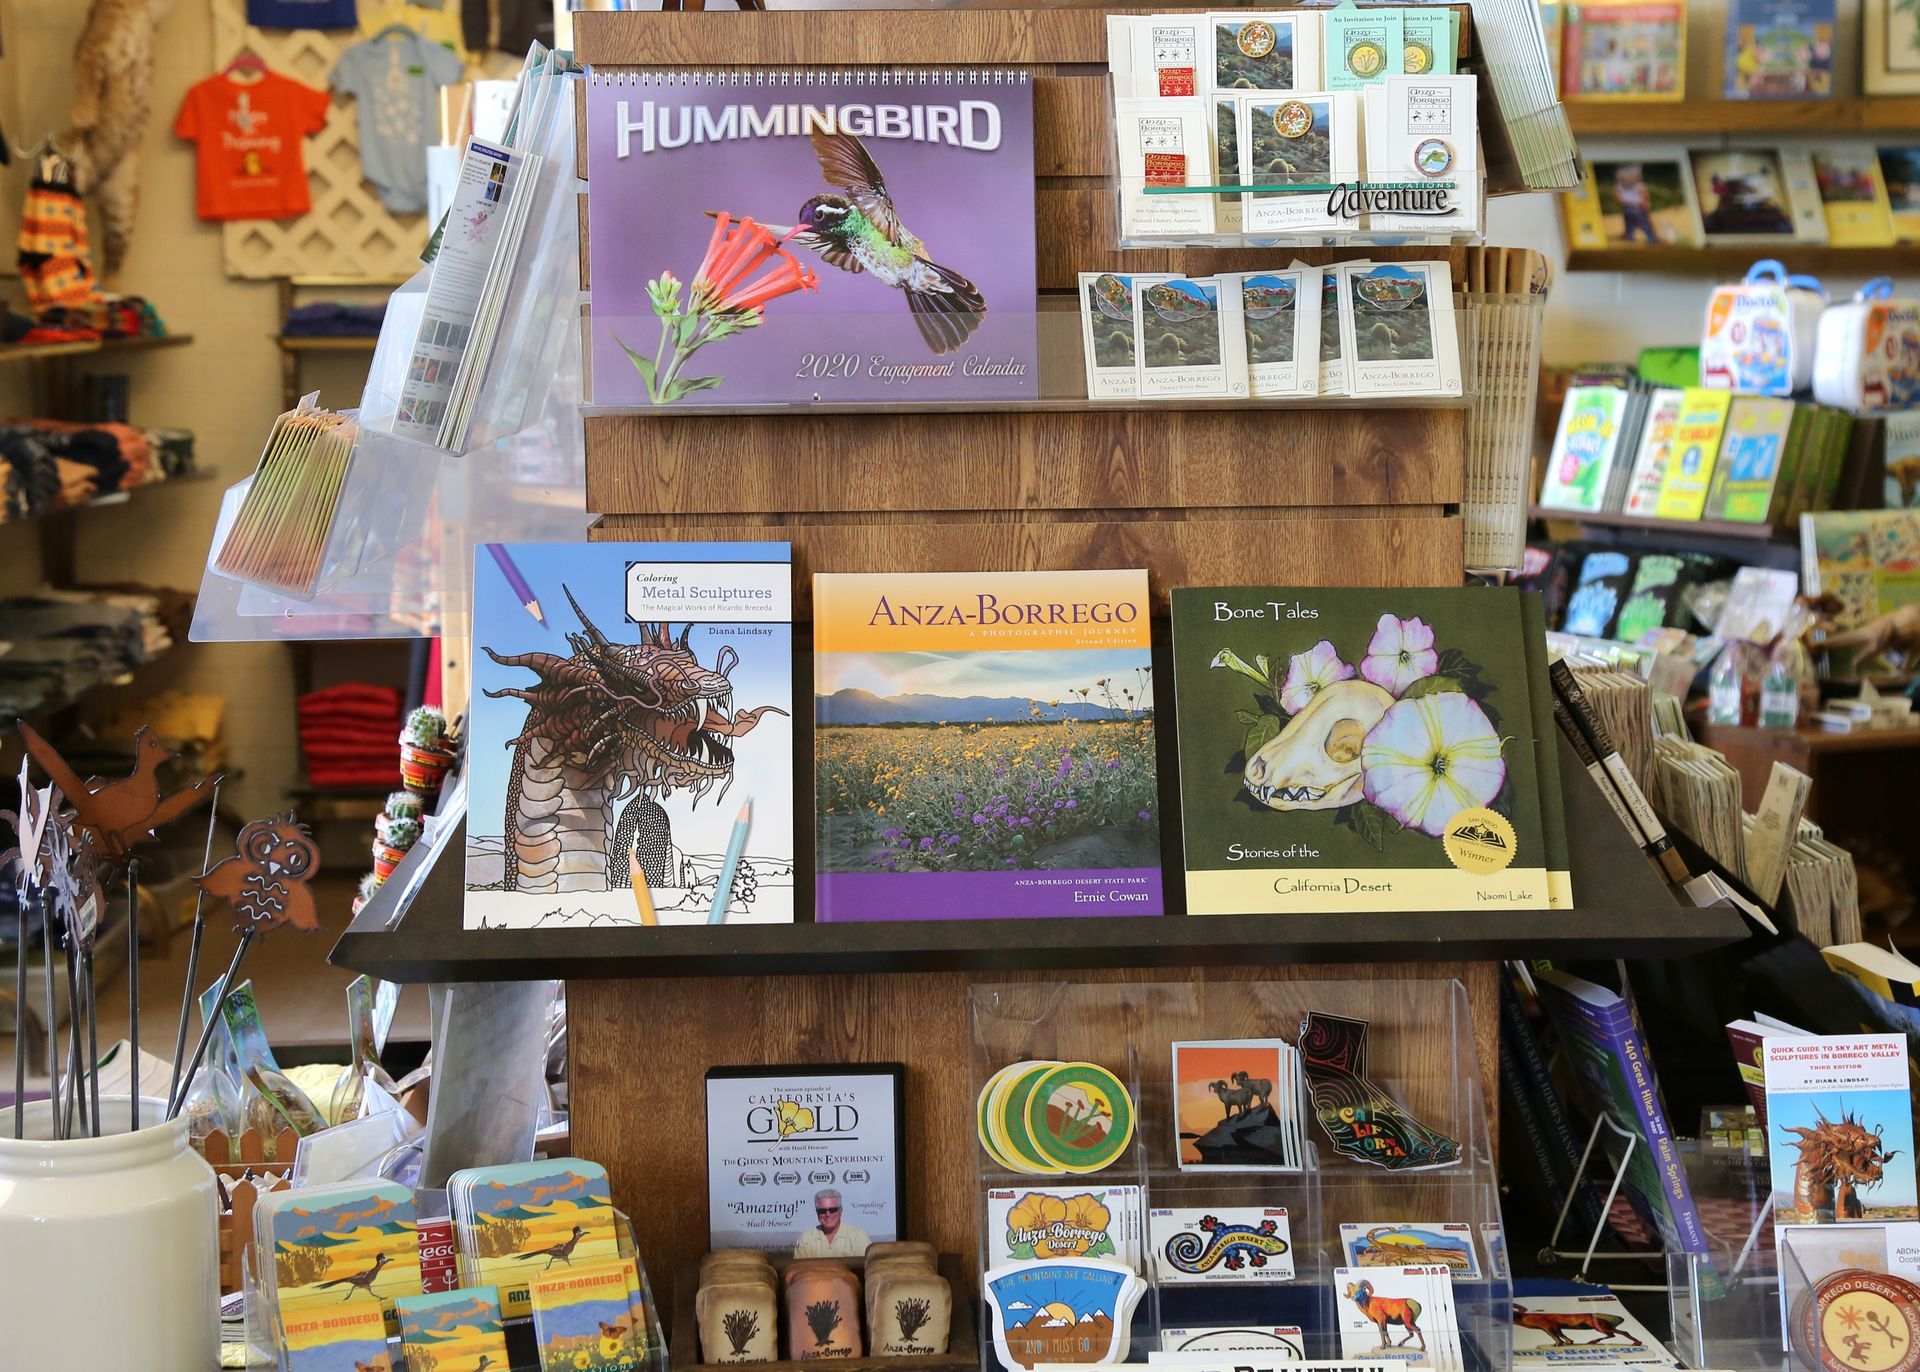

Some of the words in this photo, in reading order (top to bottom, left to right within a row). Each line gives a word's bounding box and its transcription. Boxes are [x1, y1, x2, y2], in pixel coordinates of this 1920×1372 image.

[616, 99, 1002, 159] HUMMINGBIRD
[1326, 180, 1447, 218] Adventure
[795, 352, 861, 379] 2020
[868, 355, 954, 385] Engagement
[962, 354, 1027, 378] Calendar
[1100, 377, 1136, 385] ANZA-B
[1148, 375, 1221, 385] ANZA-BORREGO
[1249, 373, 1292, 382] BORREGO
[1361, 371, 1434, 381] ANZA-BORREGO
[636, 573, 679, 585] Coloring
[641, 586, 685, 599] Metal
[689, 586, 772, 602] Sculptures
[656, 604, 683, 612] Magical
[868, 593, 1138, 628] ANZA-BORREGO
[1213, 601, 1265, 621] Bone
[1266, 601, 1319, 621] Tales
[708, 627, 735, 635] Diana
[737, 627, 773, 637] Lindsay
[982, 628, 1076, 637] PHOTOGRAPHIC
[1082, 627, 1137, 636] JOURNEY
[1106, 637, 1137, 645] Edition
[1226, 843, 1280, 861] Stories
[1282, 845, 1297, 858] of
[1299, 846, 1320, 858] the
[1458, 847, 1496, 863] Winner
[1273, 877, 1341, 894] California
[1344, 877, 1393, 894] Desert
[1074, 891, 1106, 903] Ernie
[1109, 890, 1149, 902] Cowan
[1476, 890, 1507, 902] Naomi
[1509, 890, 1533, 902] Lake
[1770, 1053, 1819, 1061] SCULPTURES
[1624, 1038, 1637, 1061] 140
[1632, 1061, 1646, 1088] Great
[1641, 1088, 1655, 1117] Hikes
[748, 1092, 856, 1105] CALIFORNIA'S
[1339, 1107, 1367, 1123] CA
[1352, 1123, 1383, 1138] LIF
[1649, 1120, 1658, 1135] near
[1655, 1122, 1664, 1134] and
[737, 1157, 770, 1167] GHOST
[772, 1156, 823, 1167] MOUNTAIN
[825, 1154, 885, 1165] EXPERIMENT
[1658, 1138, 1671, 1162] Palm
[1666, 1163, 1684, 1200] Springs
[767, 1219, 793, 1227] Howser
[1046, 1239, 1078, 1250] Desert
[1237, 1235, 1265, 1245] DESERT
[535, 1273, 623, 1294] ANZA-BORREGO
[1017, 1270, 1061, 1285] MOUNTAINS
[1065, 1270, 1080, 1280] ARE
[1083, 1272, 1114, 1286] CALLING
[1855, 1280, 1898, 1299] DESERT
[285, 1312, 380, 1334] ANZA-BORREGO
[883, 1342, 935, 1354] Anza-Borrego
[1025, 1340, 1042, 1354] AND
[1052, 1338, 1074, 1352] MUST
[1078, 1337, 1090, 1351] GO
[801, 1347, 853, 1360] Anza-Borrego
